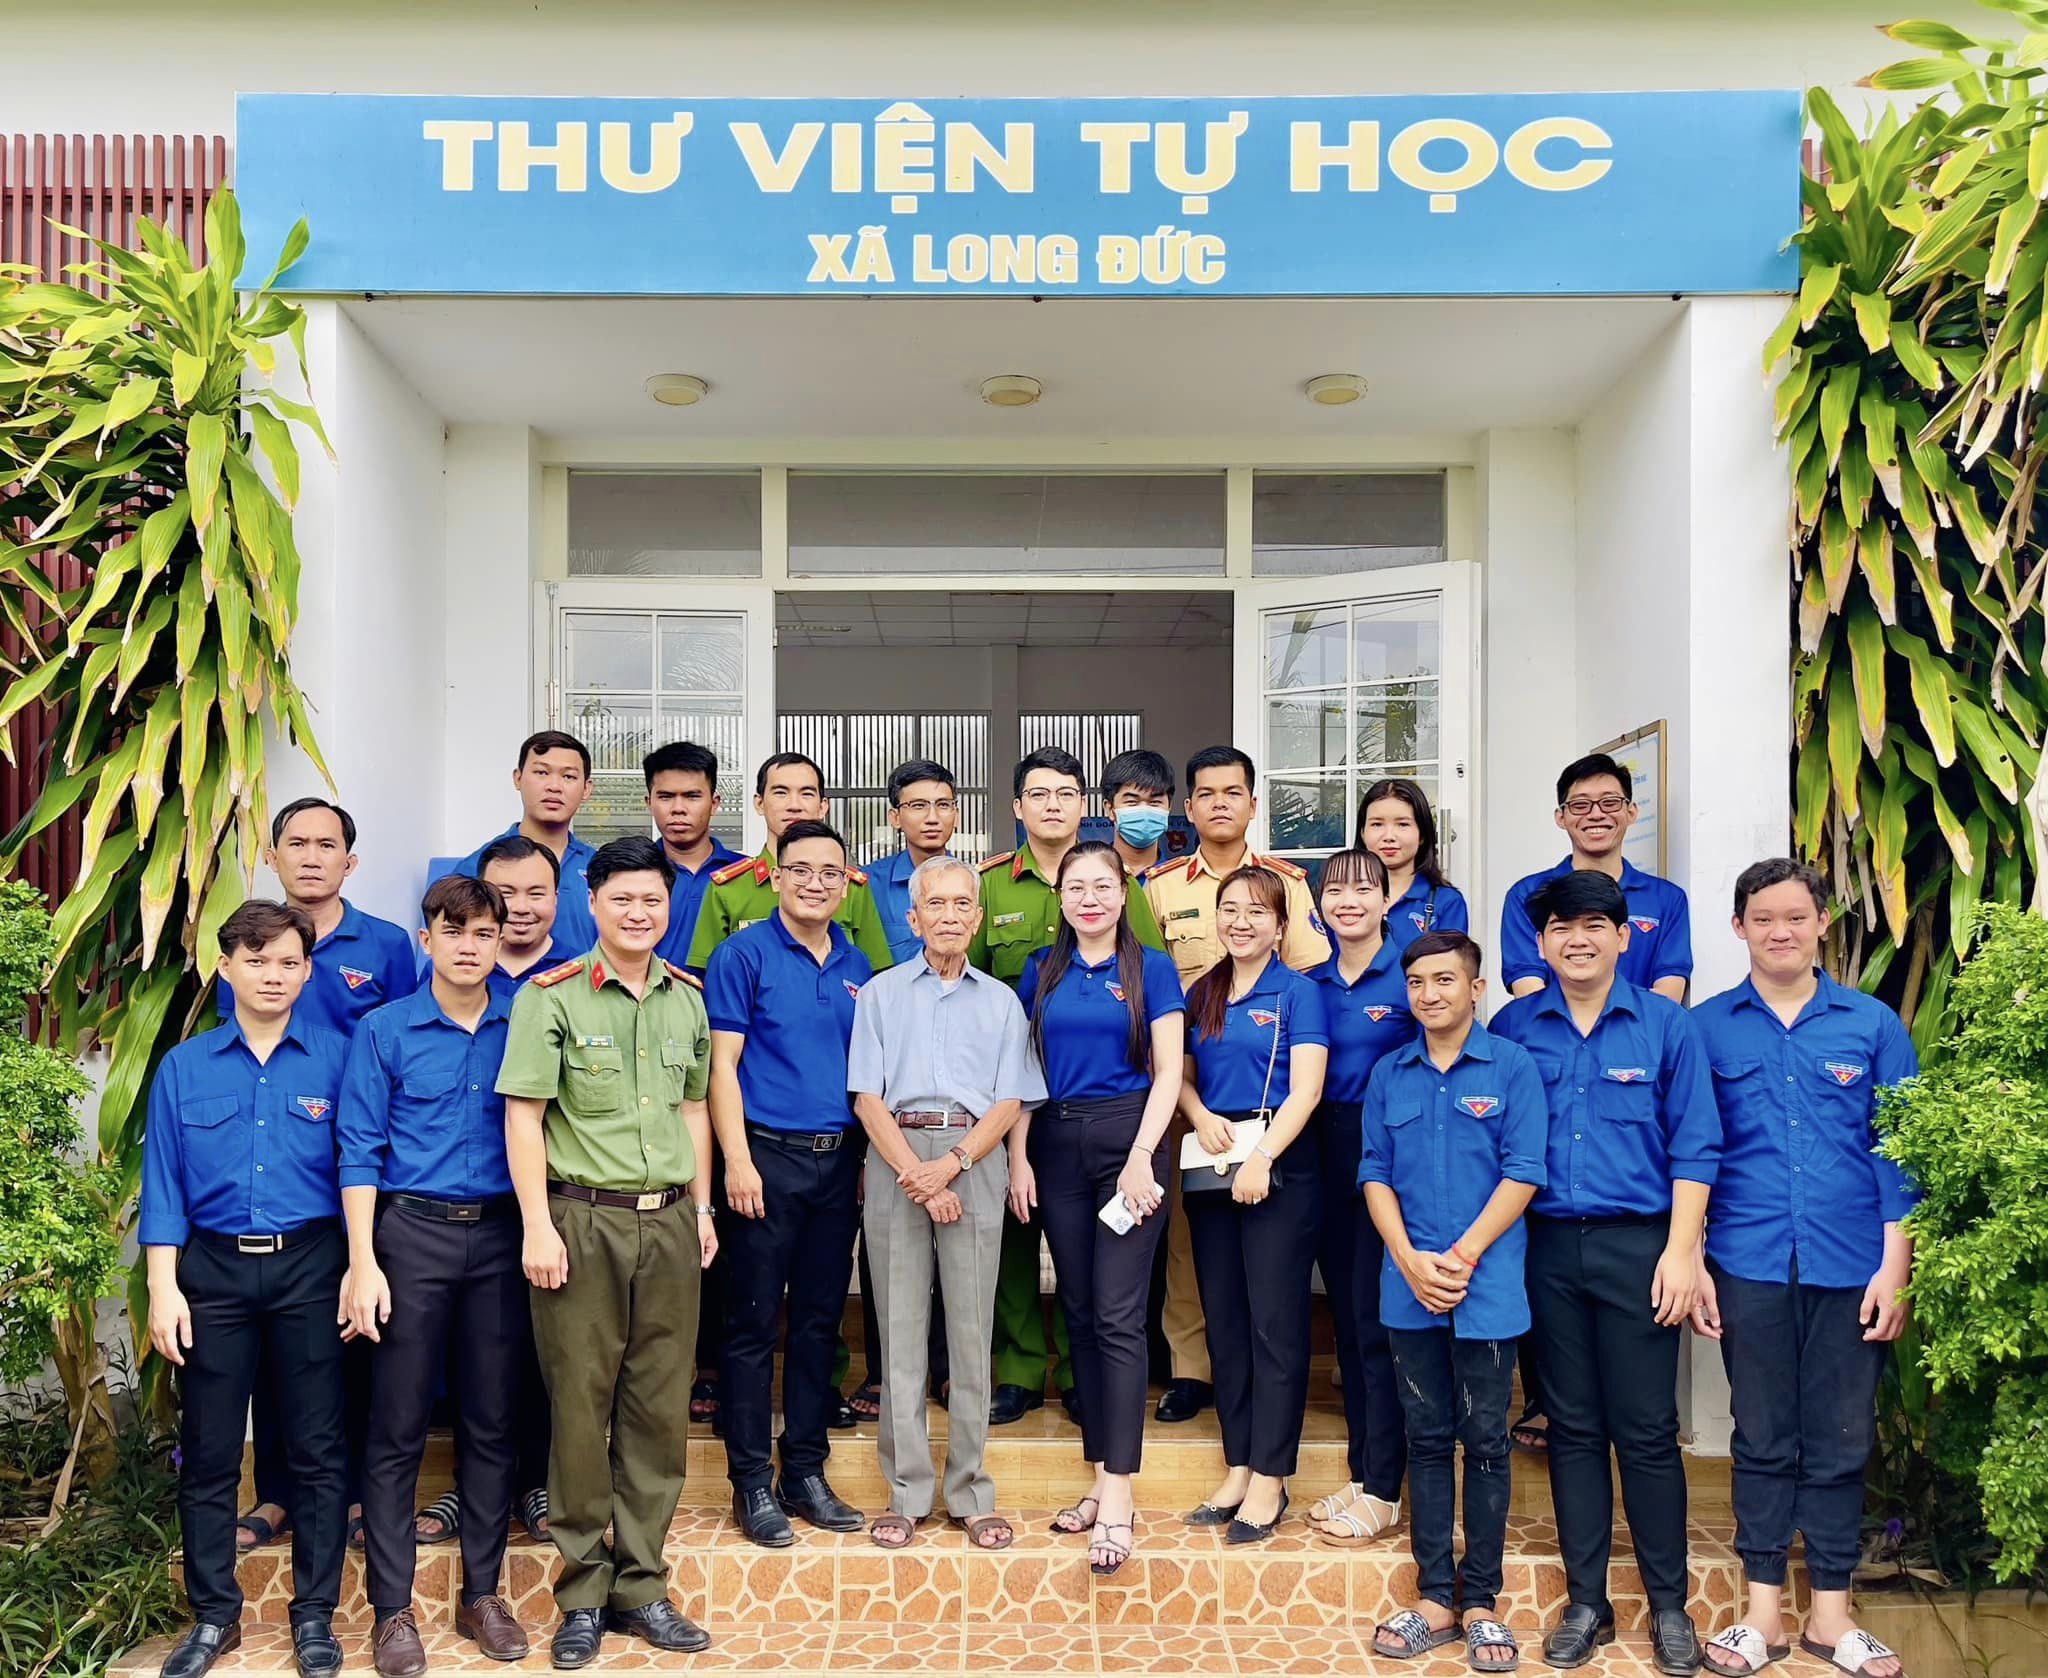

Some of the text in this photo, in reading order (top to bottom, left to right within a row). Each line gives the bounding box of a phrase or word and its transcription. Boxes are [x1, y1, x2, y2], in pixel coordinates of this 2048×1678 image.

[422, 101, 1614, 215] THƯ VIỆN TỰ HỌC
[806, 225, 1226, 285] XÃ LONG ĐỨC
